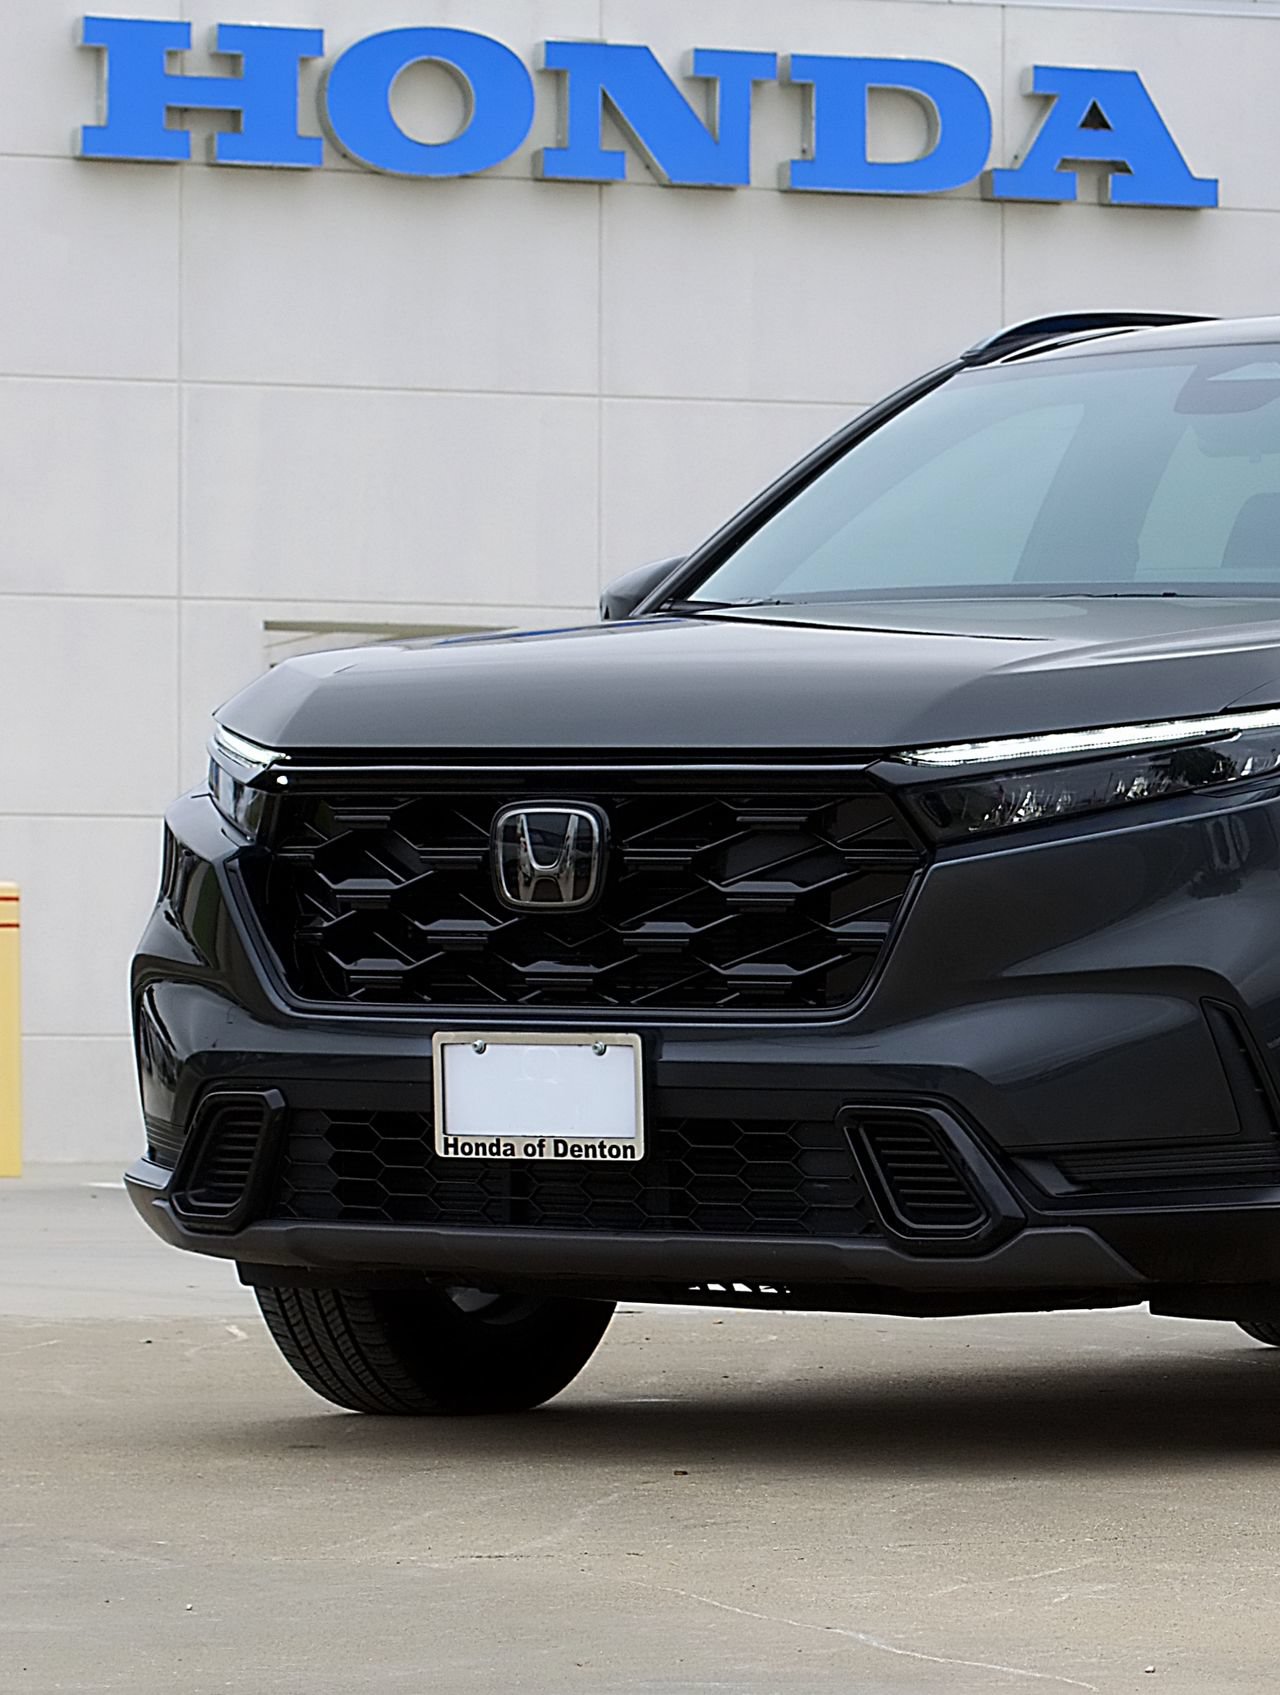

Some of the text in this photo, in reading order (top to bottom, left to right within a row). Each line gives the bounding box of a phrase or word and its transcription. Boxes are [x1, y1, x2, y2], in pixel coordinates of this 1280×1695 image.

[76, 15, 1219, 208] HONDA
[443, 1137, 636, 1159] Honda of Denton
